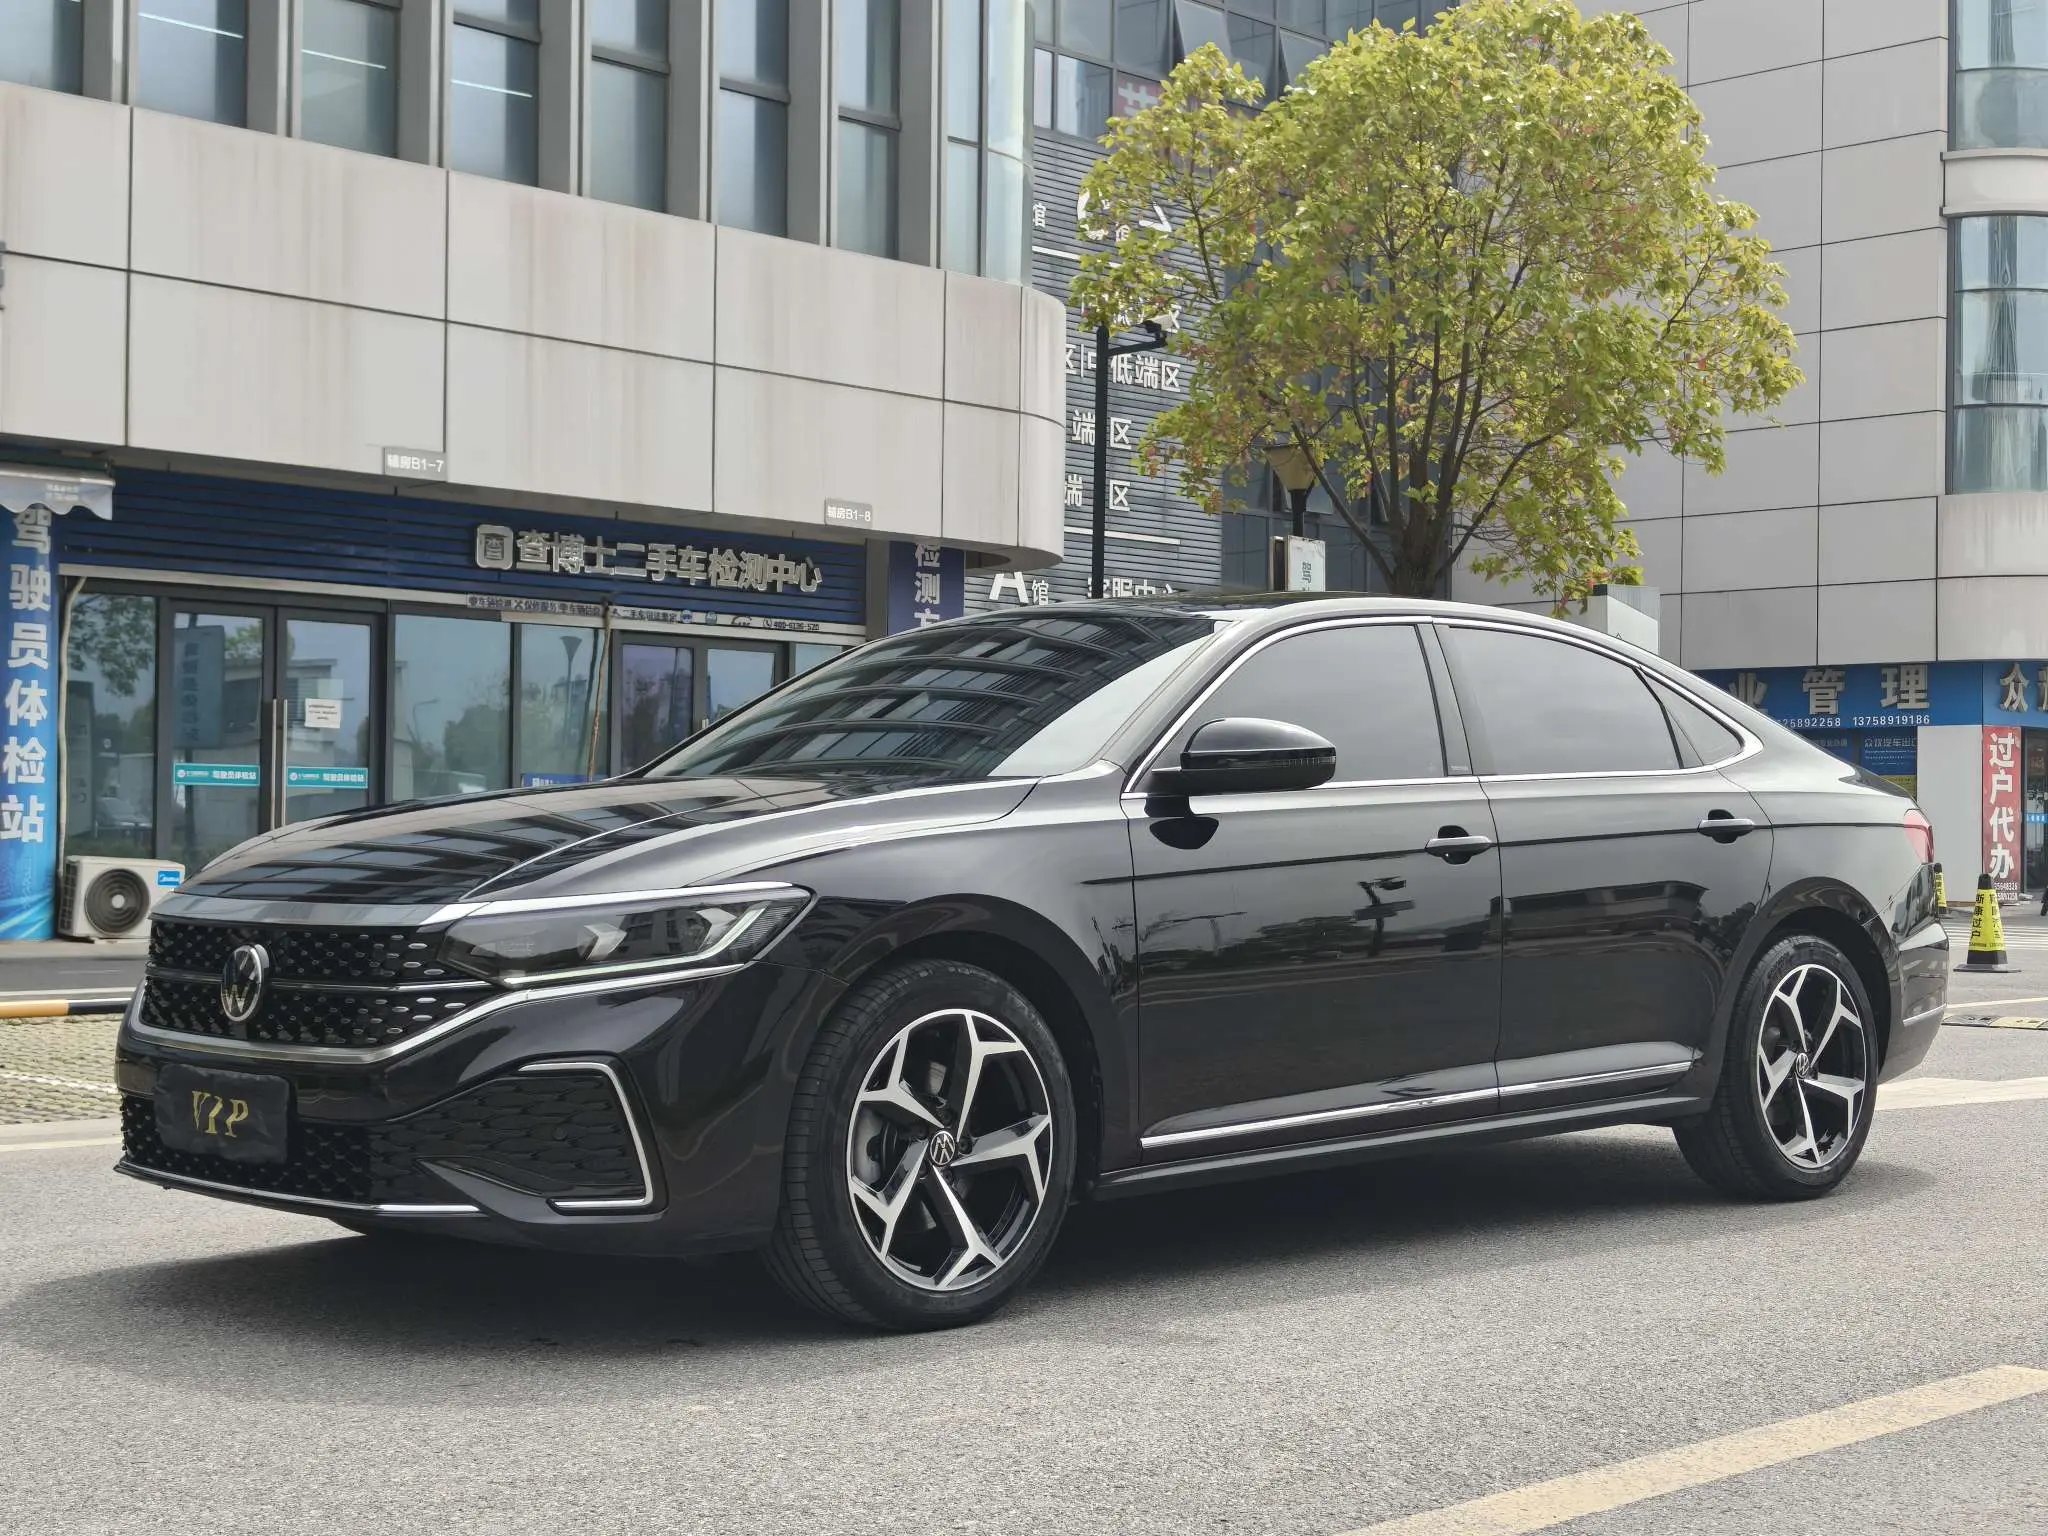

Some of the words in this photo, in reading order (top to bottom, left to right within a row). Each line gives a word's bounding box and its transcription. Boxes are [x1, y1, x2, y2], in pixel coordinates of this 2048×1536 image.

[516, 529, 823, 592] 查博士二手车检测中心
[0, 508, 52, 843] 驾驶员体检站
[1853, 714, 1930, 726] 13758919186
[1988, 732, 2015, 879] 过户代办
[191, 1090, 249, 1138] VIP
